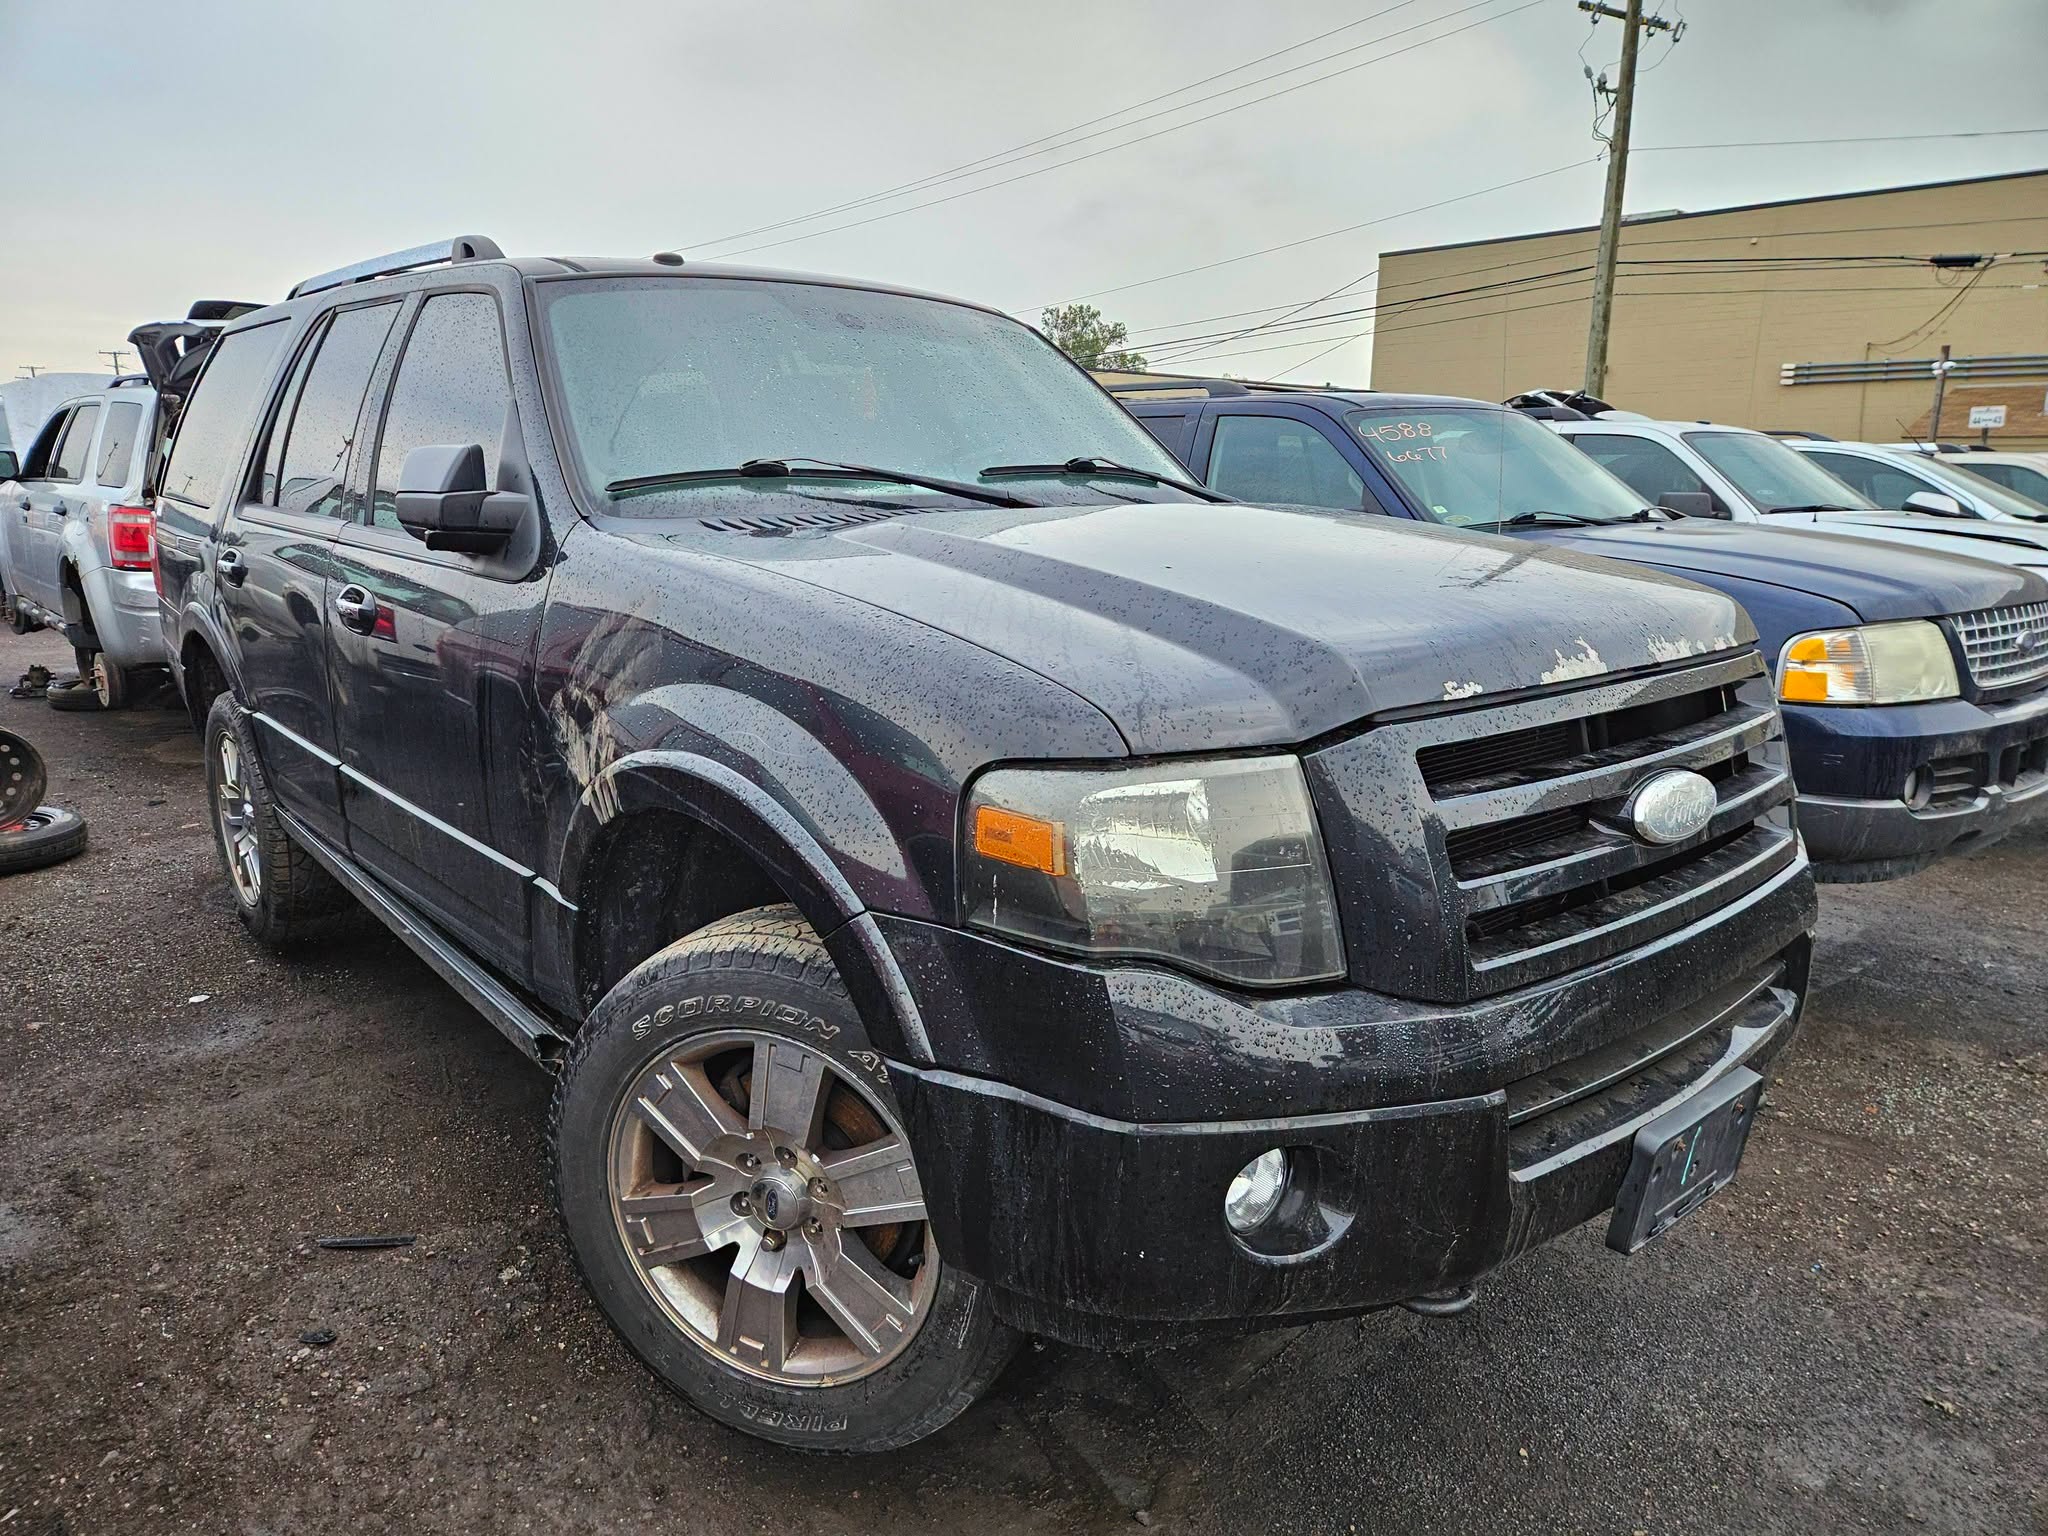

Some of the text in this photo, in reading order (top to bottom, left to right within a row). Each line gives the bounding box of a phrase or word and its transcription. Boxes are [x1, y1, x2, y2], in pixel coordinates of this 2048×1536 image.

[1358, 423, 1431, 443] 4588
[1663, 786, 1707, 827] Ford
[631, 993, 841, 1041] SCORPION
